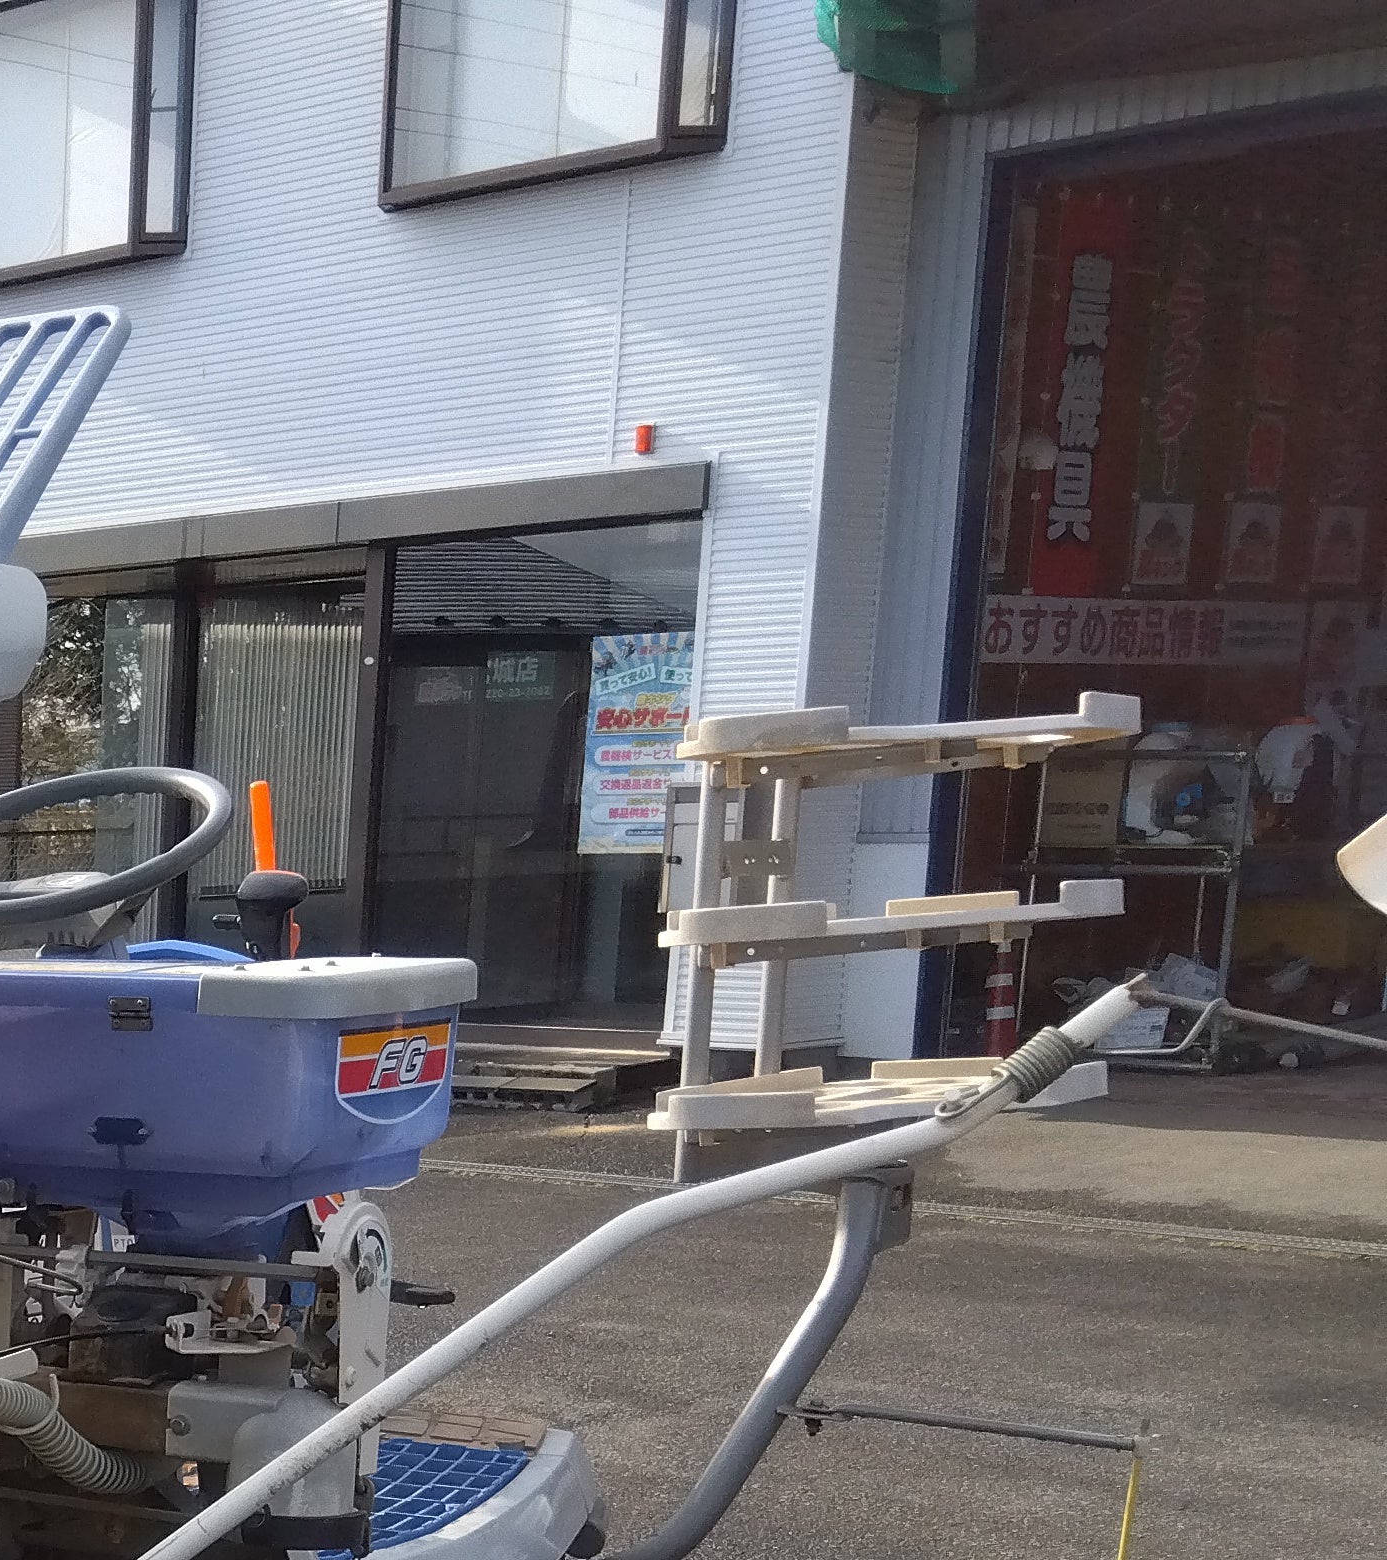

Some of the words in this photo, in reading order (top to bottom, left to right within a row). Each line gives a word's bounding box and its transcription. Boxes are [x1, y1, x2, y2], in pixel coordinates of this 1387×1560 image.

[984, 604, 1224, 661] おすすめ商品情報
[369, 1035, 428, 1090] FG
